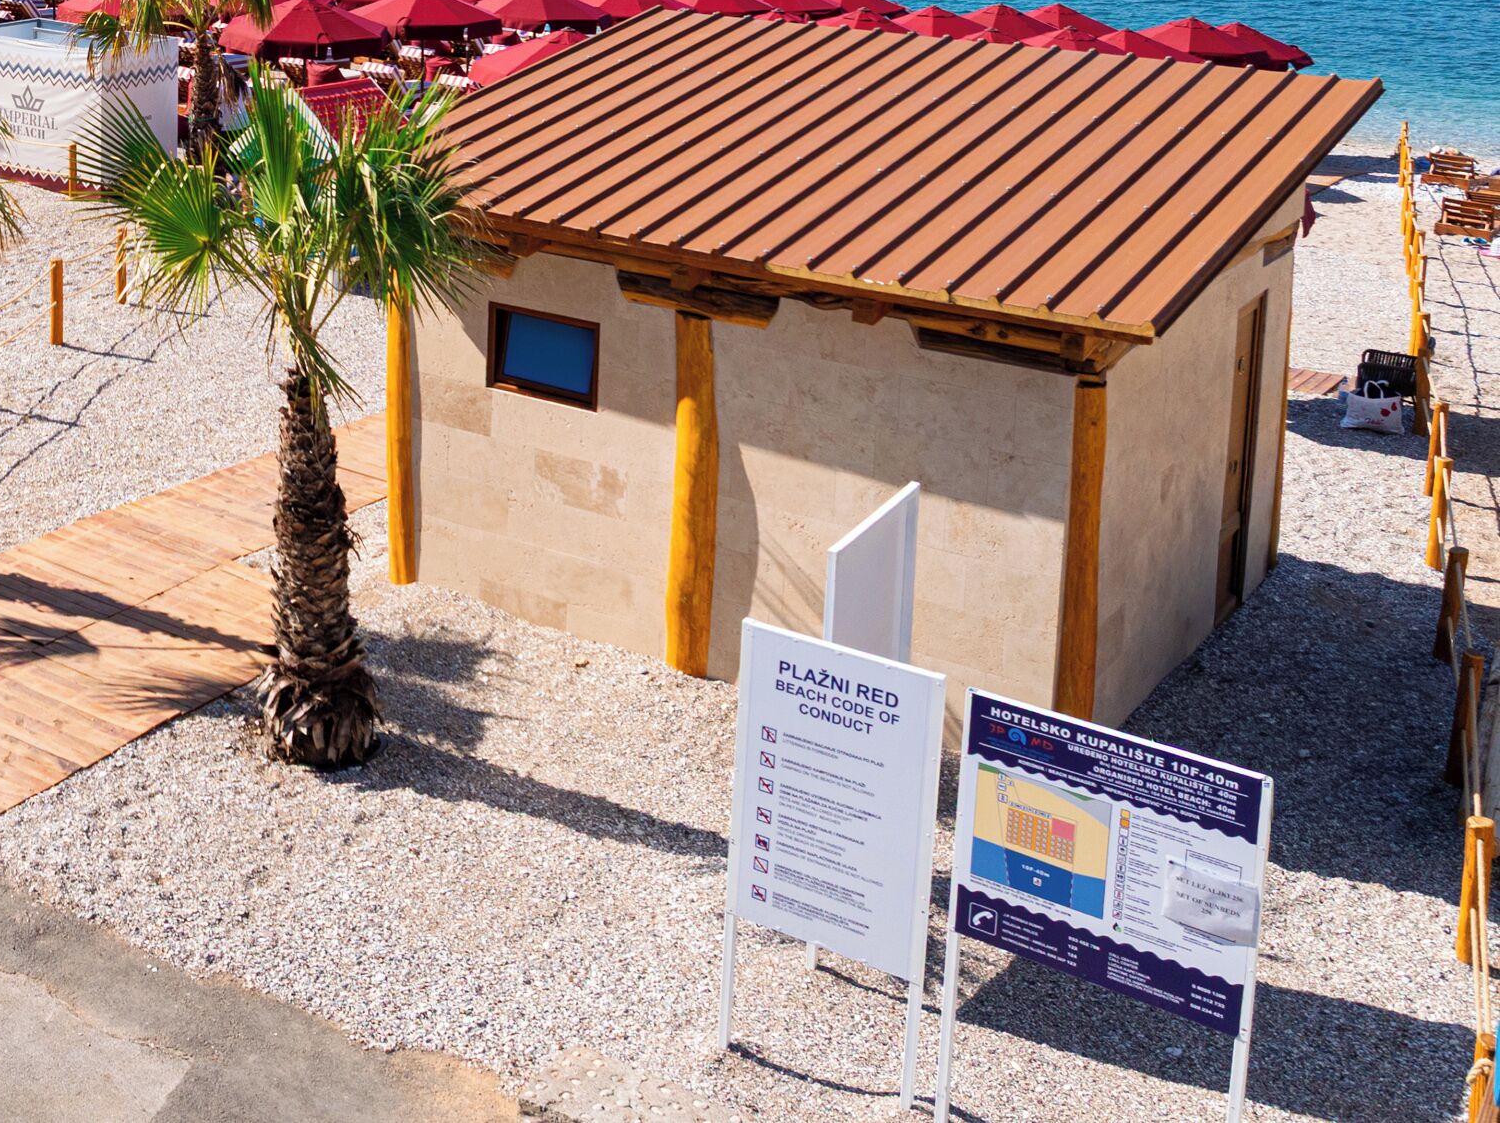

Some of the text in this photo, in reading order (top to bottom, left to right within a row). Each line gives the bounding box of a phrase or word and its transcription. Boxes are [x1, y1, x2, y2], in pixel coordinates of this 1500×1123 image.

[0, 107, 58, 130] IMPERIAL
[10, 124, 45, 139] BEACH
[775, 679, 900, 726] BEACH CODE OF
[778, 660, 898, 708] PLAŽNI RED
[799, 702, 873, 735] CONDUCT
[990, 706, 1070, 739] HOTELSKO
[1076, 732, 1164, 767] KUPALIŠTE
[1171, 760, 1239, 790] 10F-40m
[1093, 765, 1236, 815] ORGANISED HOTEL BEACH: 40m
[1111, 757, 1157, 776] HOTELSKO
[1160, 771, 1212, 793] KUPALIŠTE:
[1218, 789, 1237, 800] 40m
[1192, 896, 1202, 905] OF
